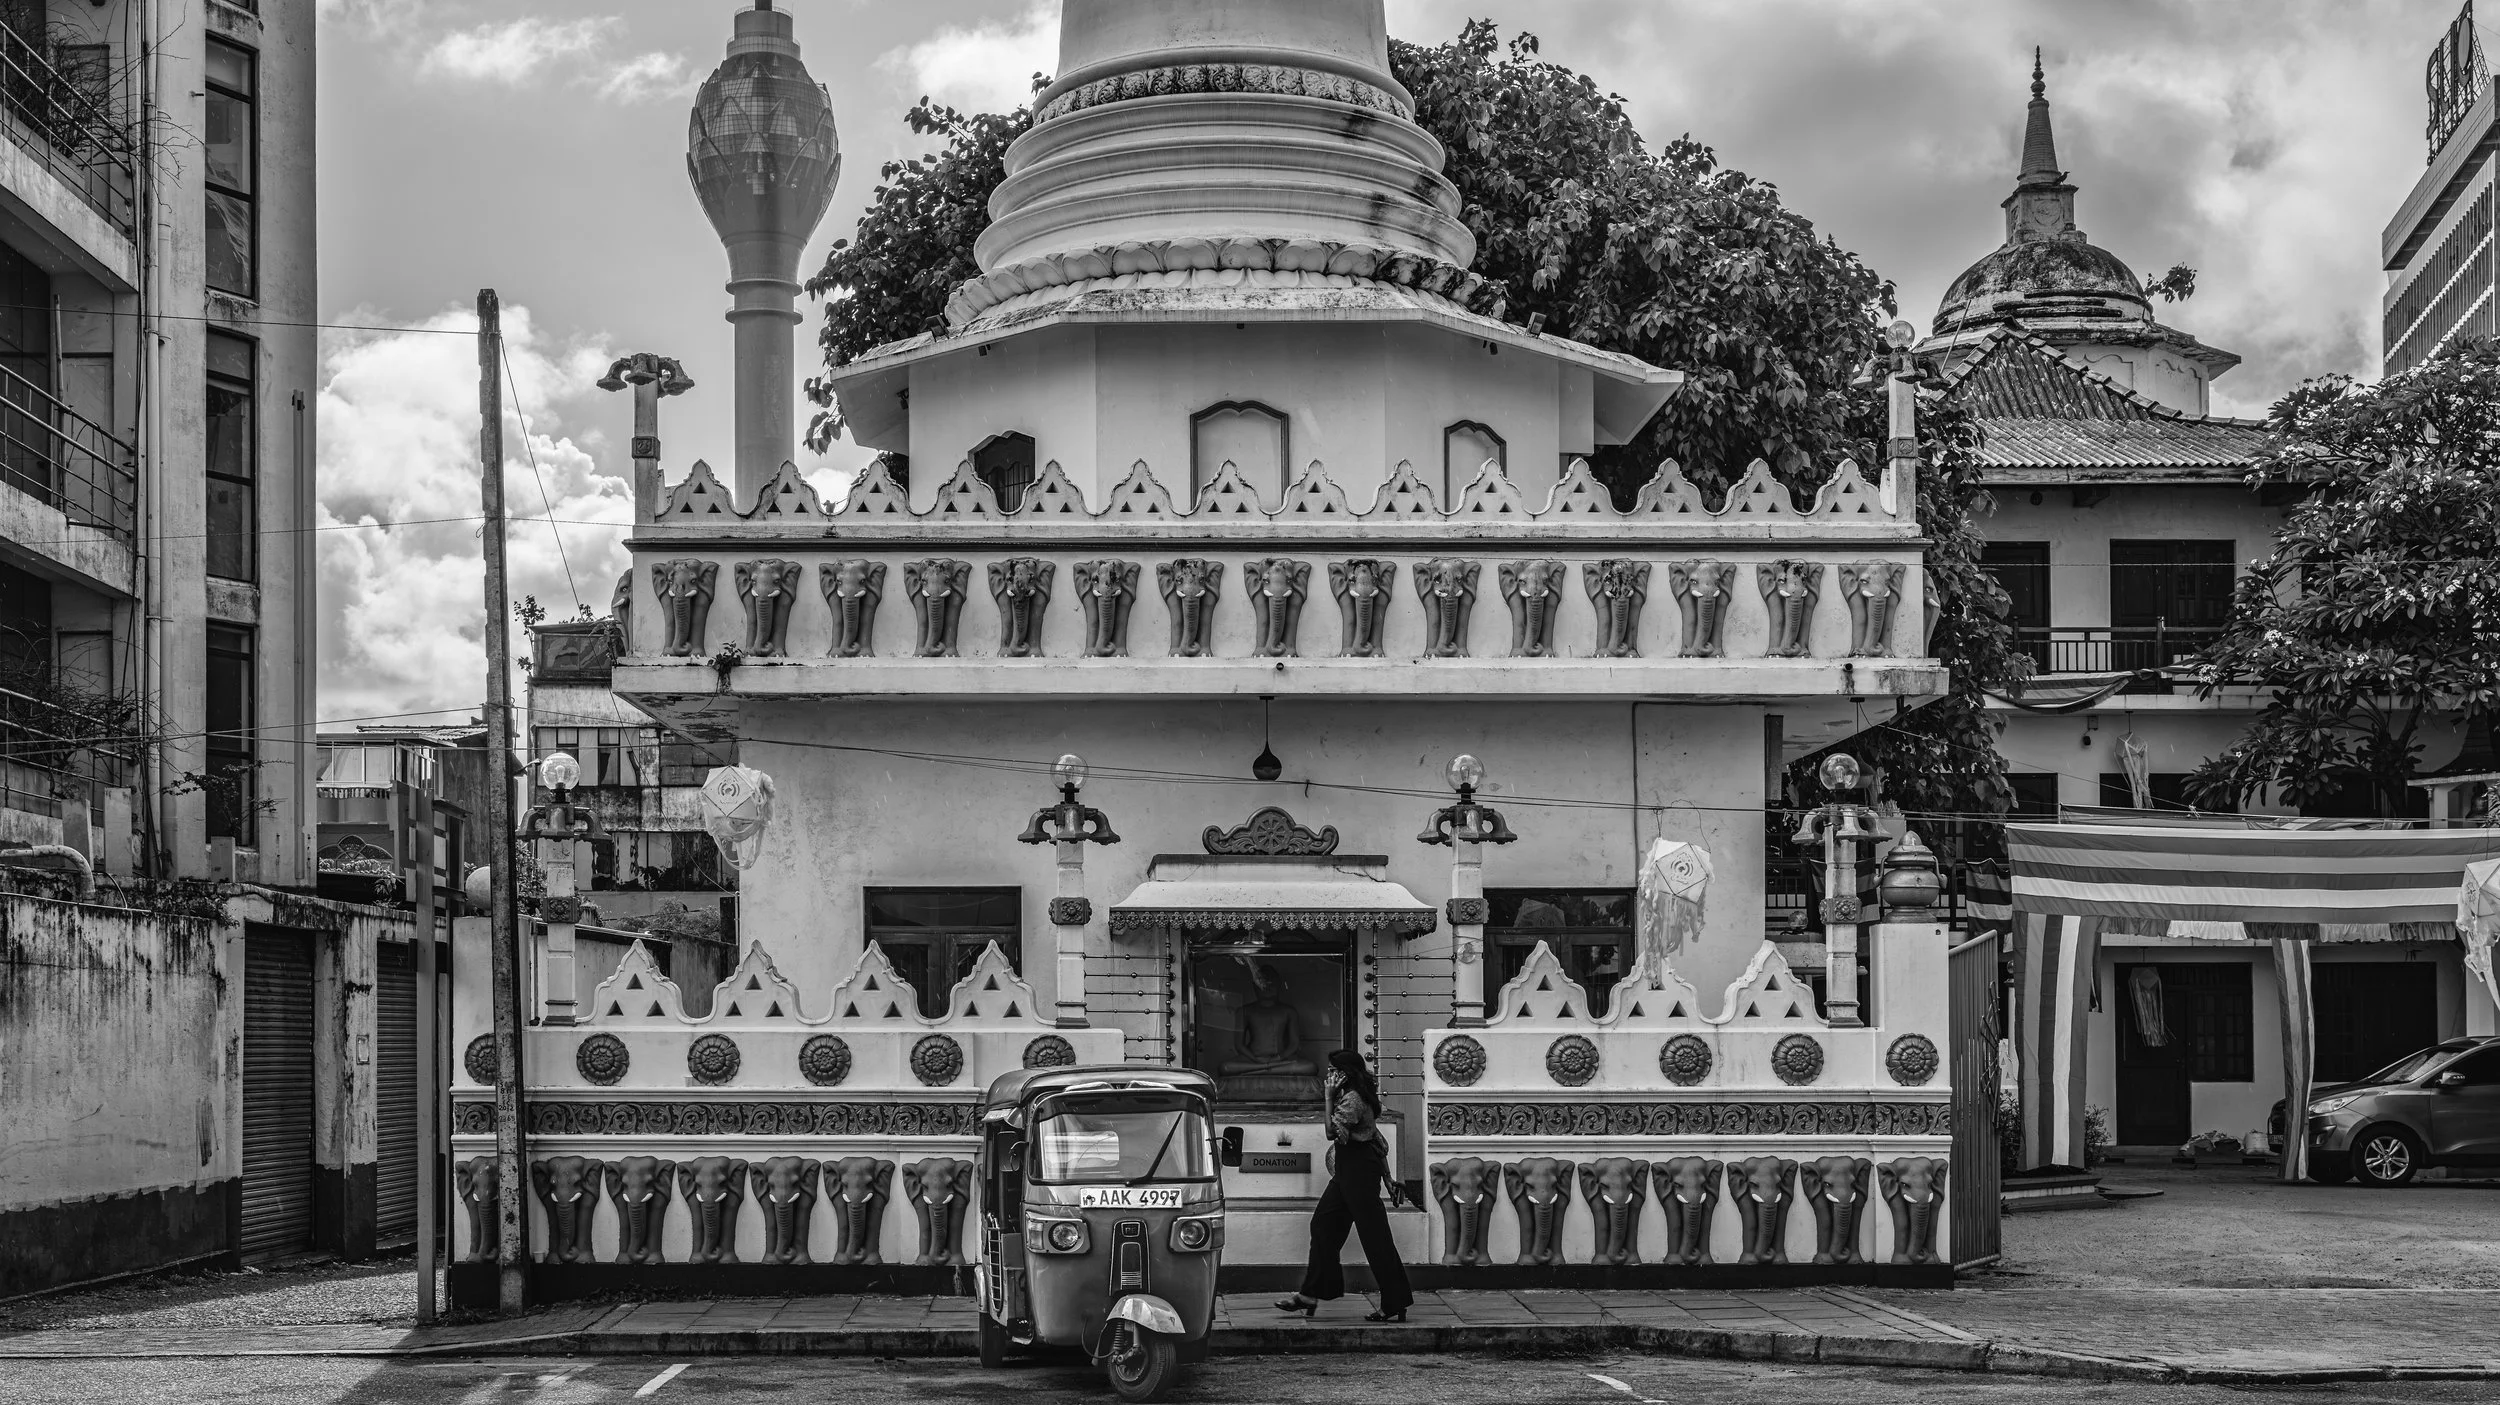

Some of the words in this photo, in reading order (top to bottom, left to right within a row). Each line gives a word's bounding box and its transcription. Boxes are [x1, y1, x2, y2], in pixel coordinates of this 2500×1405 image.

[1253, 1158, 1297, 1167] DONATION
[1099, 1189, 1131, 1206] AAK
[1139, 1190, 1180, 1206] 4997
